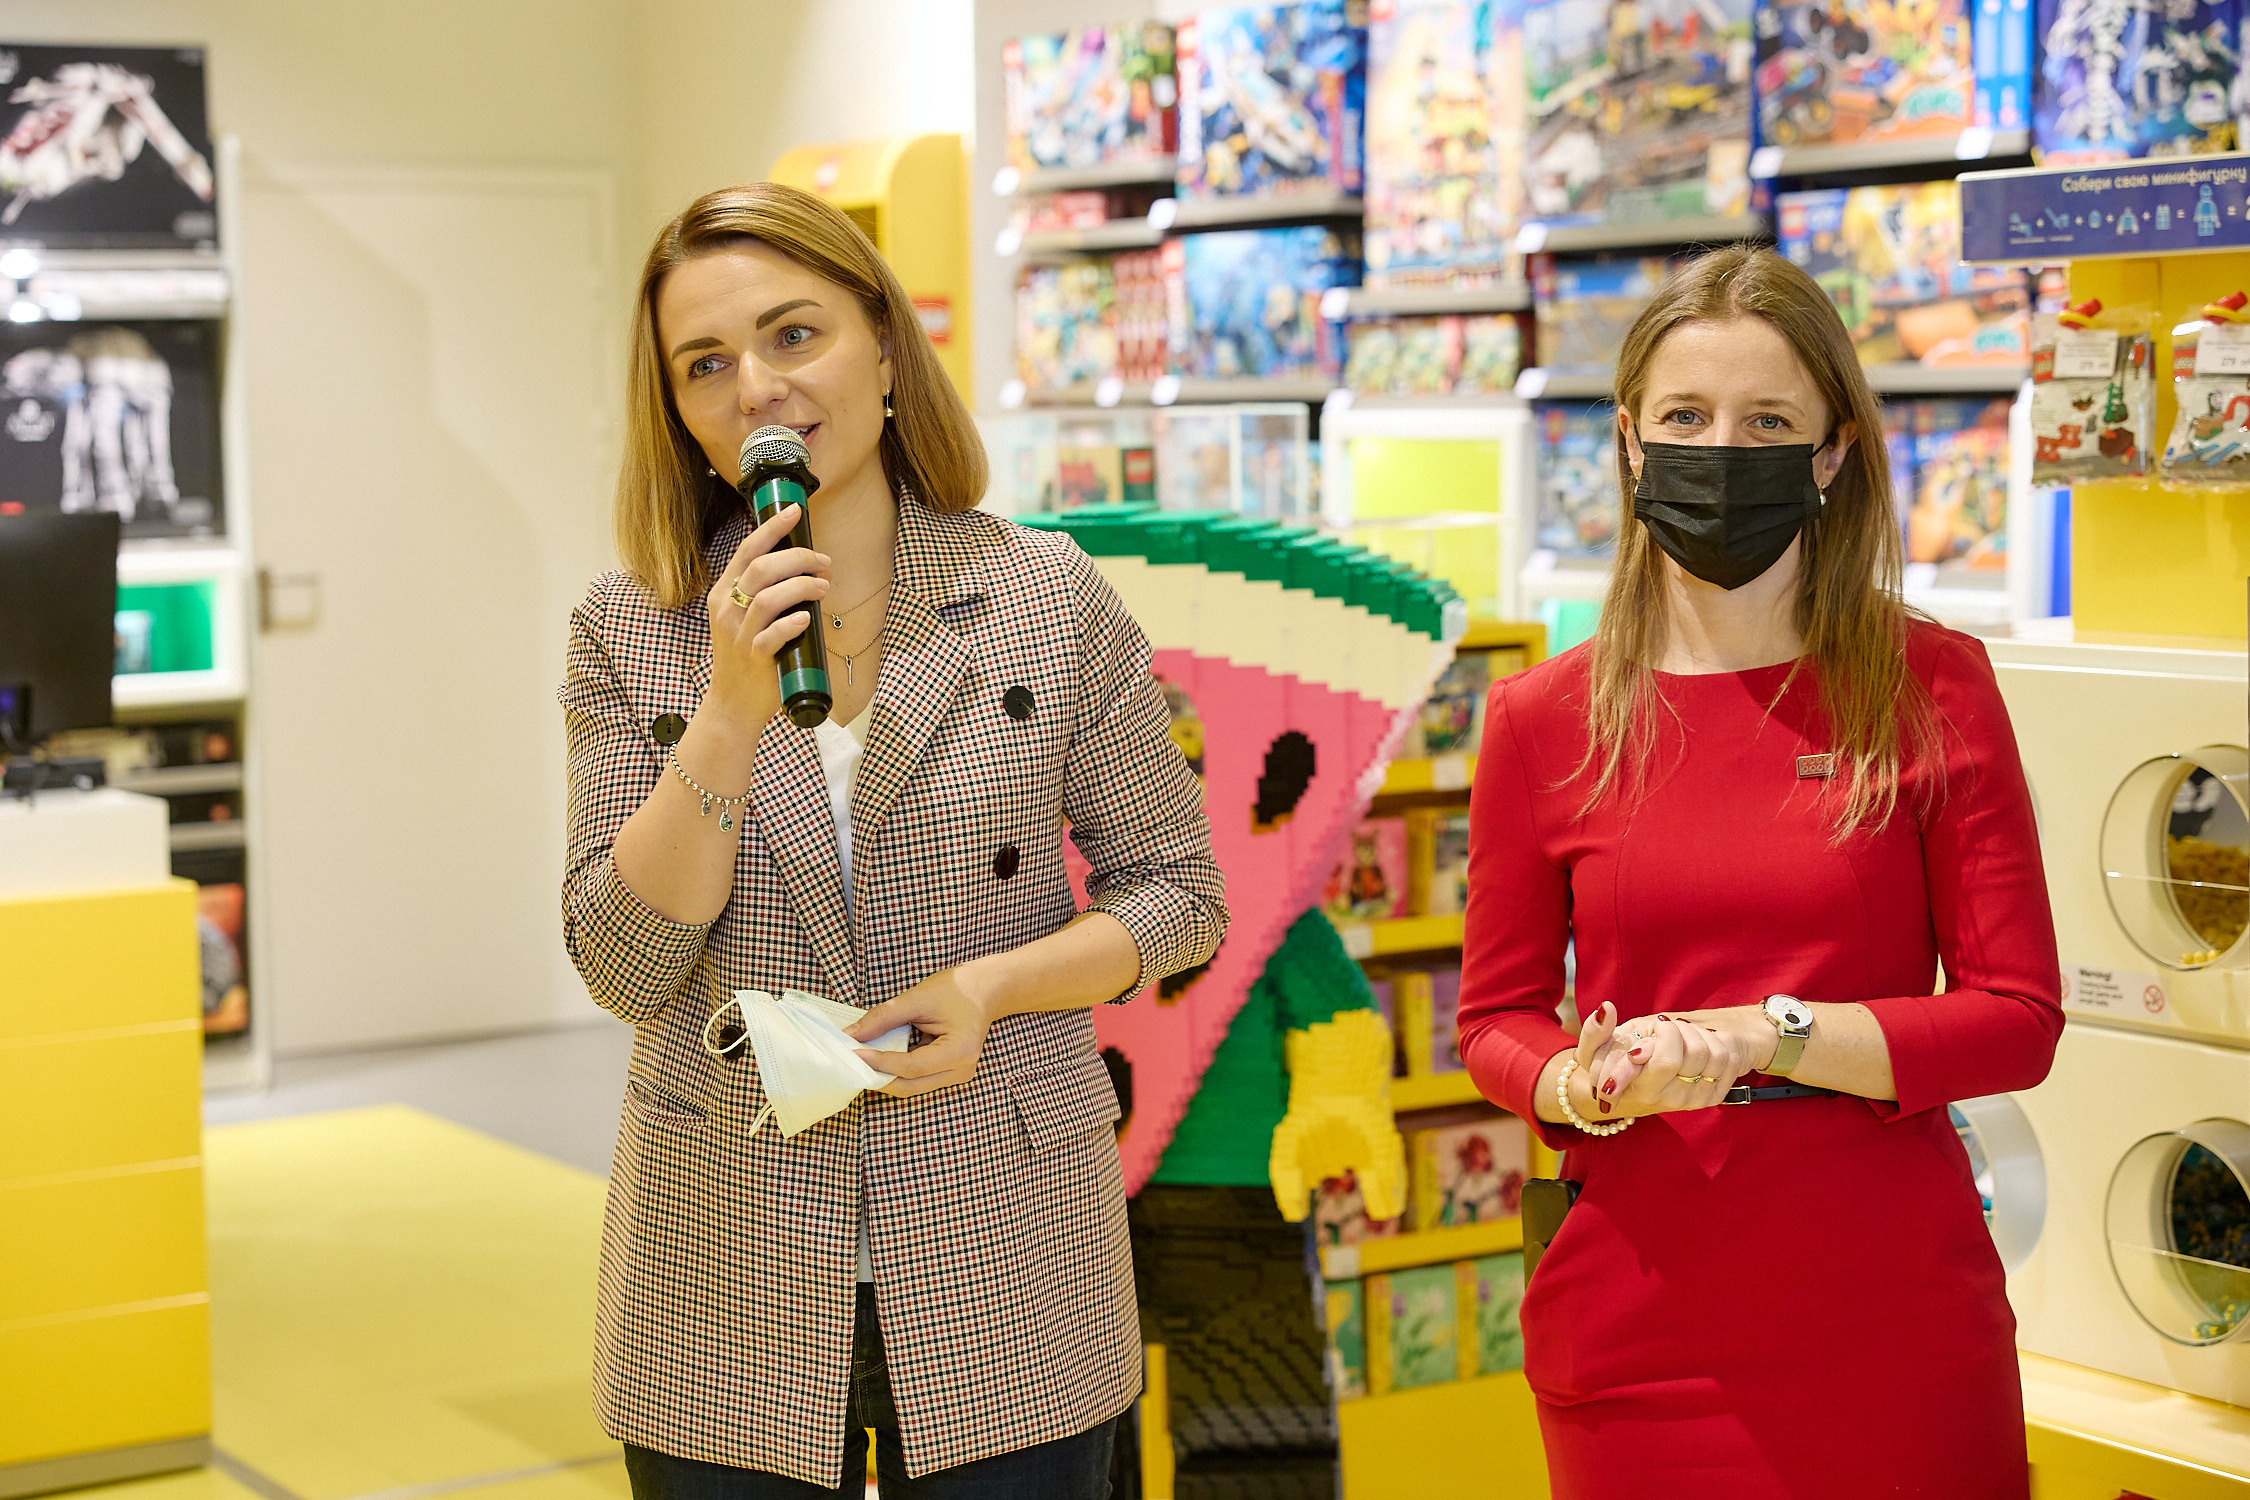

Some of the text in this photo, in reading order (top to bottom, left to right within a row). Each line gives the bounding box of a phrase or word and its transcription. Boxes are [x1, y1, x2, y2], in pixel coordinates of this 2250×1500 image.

[2062, 167, 2247, 194] Собери свою минифигурку
